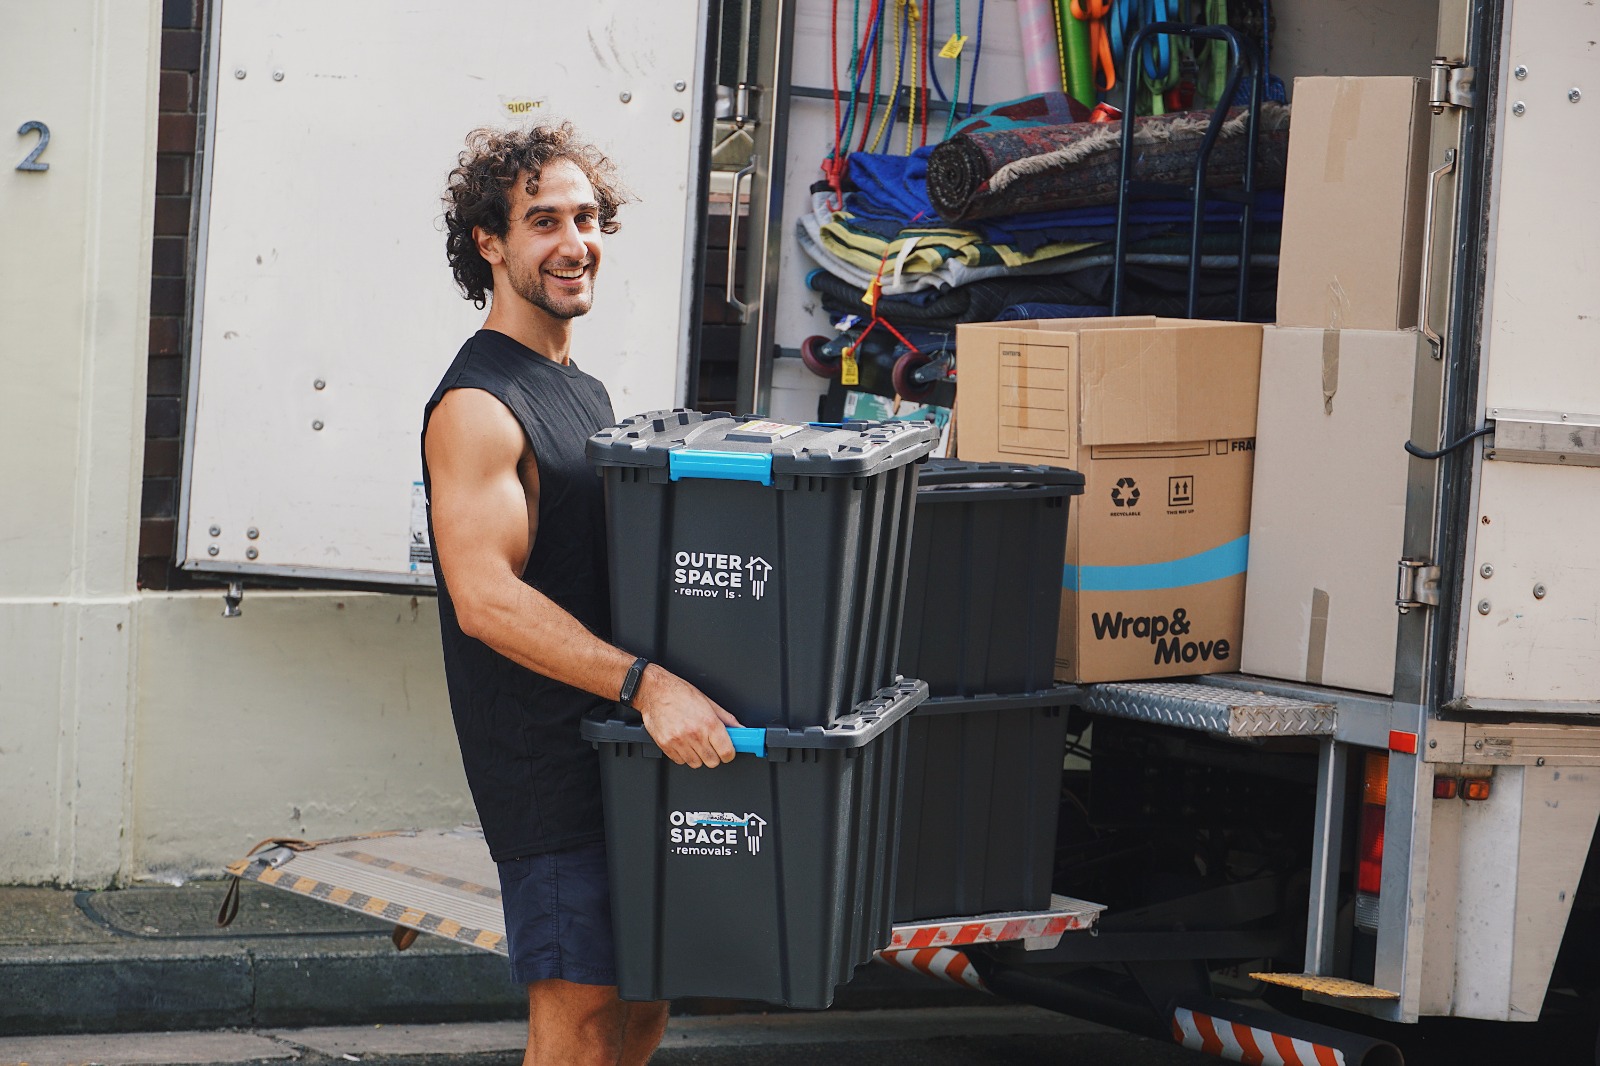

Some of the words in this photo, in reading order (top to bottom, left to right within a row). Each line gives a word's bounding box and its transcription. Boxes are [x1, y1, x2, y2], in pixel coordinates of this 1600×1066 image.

[15, 120, 50, 171] 2
[675, 551, 742, 570] OUTER
[674, 569, 742, 587] SPACE
[680, 587, 735, 599] removls
[1091, 608, 1191, 645] Wrap&
[1154, 637, 1230, 665] Move
[670, 828, 738, 845] SPACE
[676, 846, 732, 856] removals
